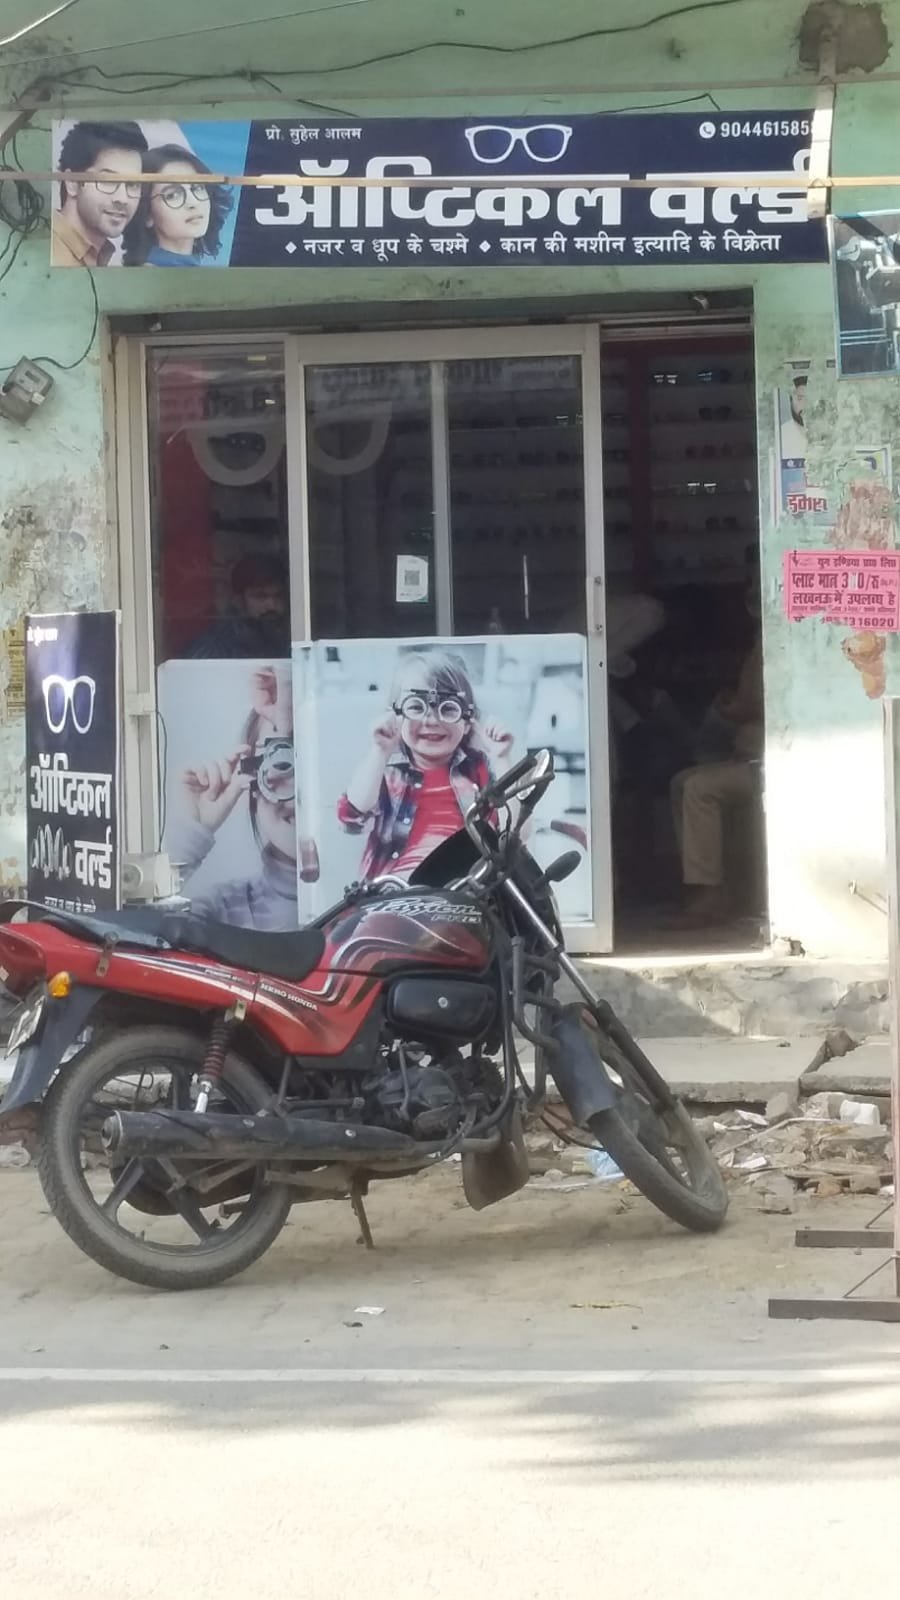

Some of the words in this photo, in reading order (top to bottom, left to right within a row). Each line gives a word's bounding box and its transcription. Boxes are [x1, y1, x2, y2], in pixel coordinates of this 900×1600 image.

[290, 125, 319, 144] सुहेल
[324, 128, 362, 141] आलम
[720, 120, 814, 138] 904461585
[255, 156, 630, 229] ऑप्टिकल
[304, 238, 344, 254] नजर
[350, 239, 364, 253] व
[372, 238, 399, 263] धूप
[407, 233, 423, 254] के
[430, 233, 469, 255] चश्मे
[501, 237, 536, 253] कान
[544, 230, 566, 253] की
[574, 230, 625, 253] मशीन
[633, 229, 691, 255] इत्यादि
[699, 231, 717, 251] के
[723, 229, 781, 253] विक्रेता
[30, 753, 112, 818] ऑप्टिकल
[74, 825, 112, 889] वर्ल्ड
[260, 983, 287, 998] HERO
[287, 992, 318, 1011] HONDA
